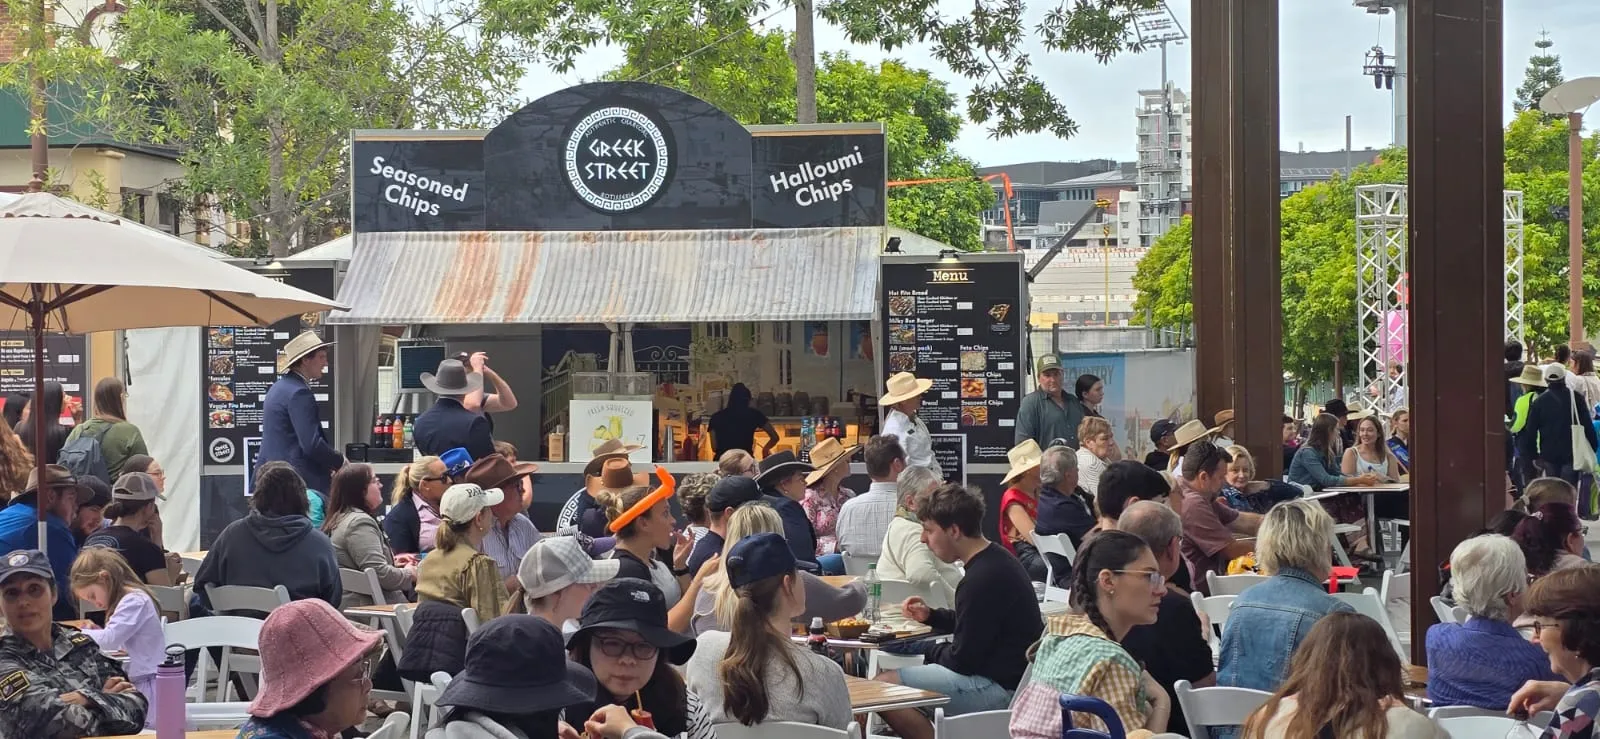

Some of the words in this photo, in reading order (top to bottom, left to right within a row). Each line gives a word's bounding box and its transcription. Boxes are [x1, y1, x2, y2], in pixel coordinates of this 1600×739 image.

[585, 118, 616, 138] AUTHENTIC
[589, 139, 646, 157] GREEK
[585, 161, 651, 180] STREET
[769, 145, 864, 193] Halloumi
[370, 156, 469, 202] Seasoned
[384, 184, 440, 216] Chips
[795, 178, 854, 207] Chips
[933, 271, 968, 281] Menu
[973, 344, 989, 352] Chips
[986, 370, 1002, 379] Chips
[988, 399, 1004, 407] Chips
